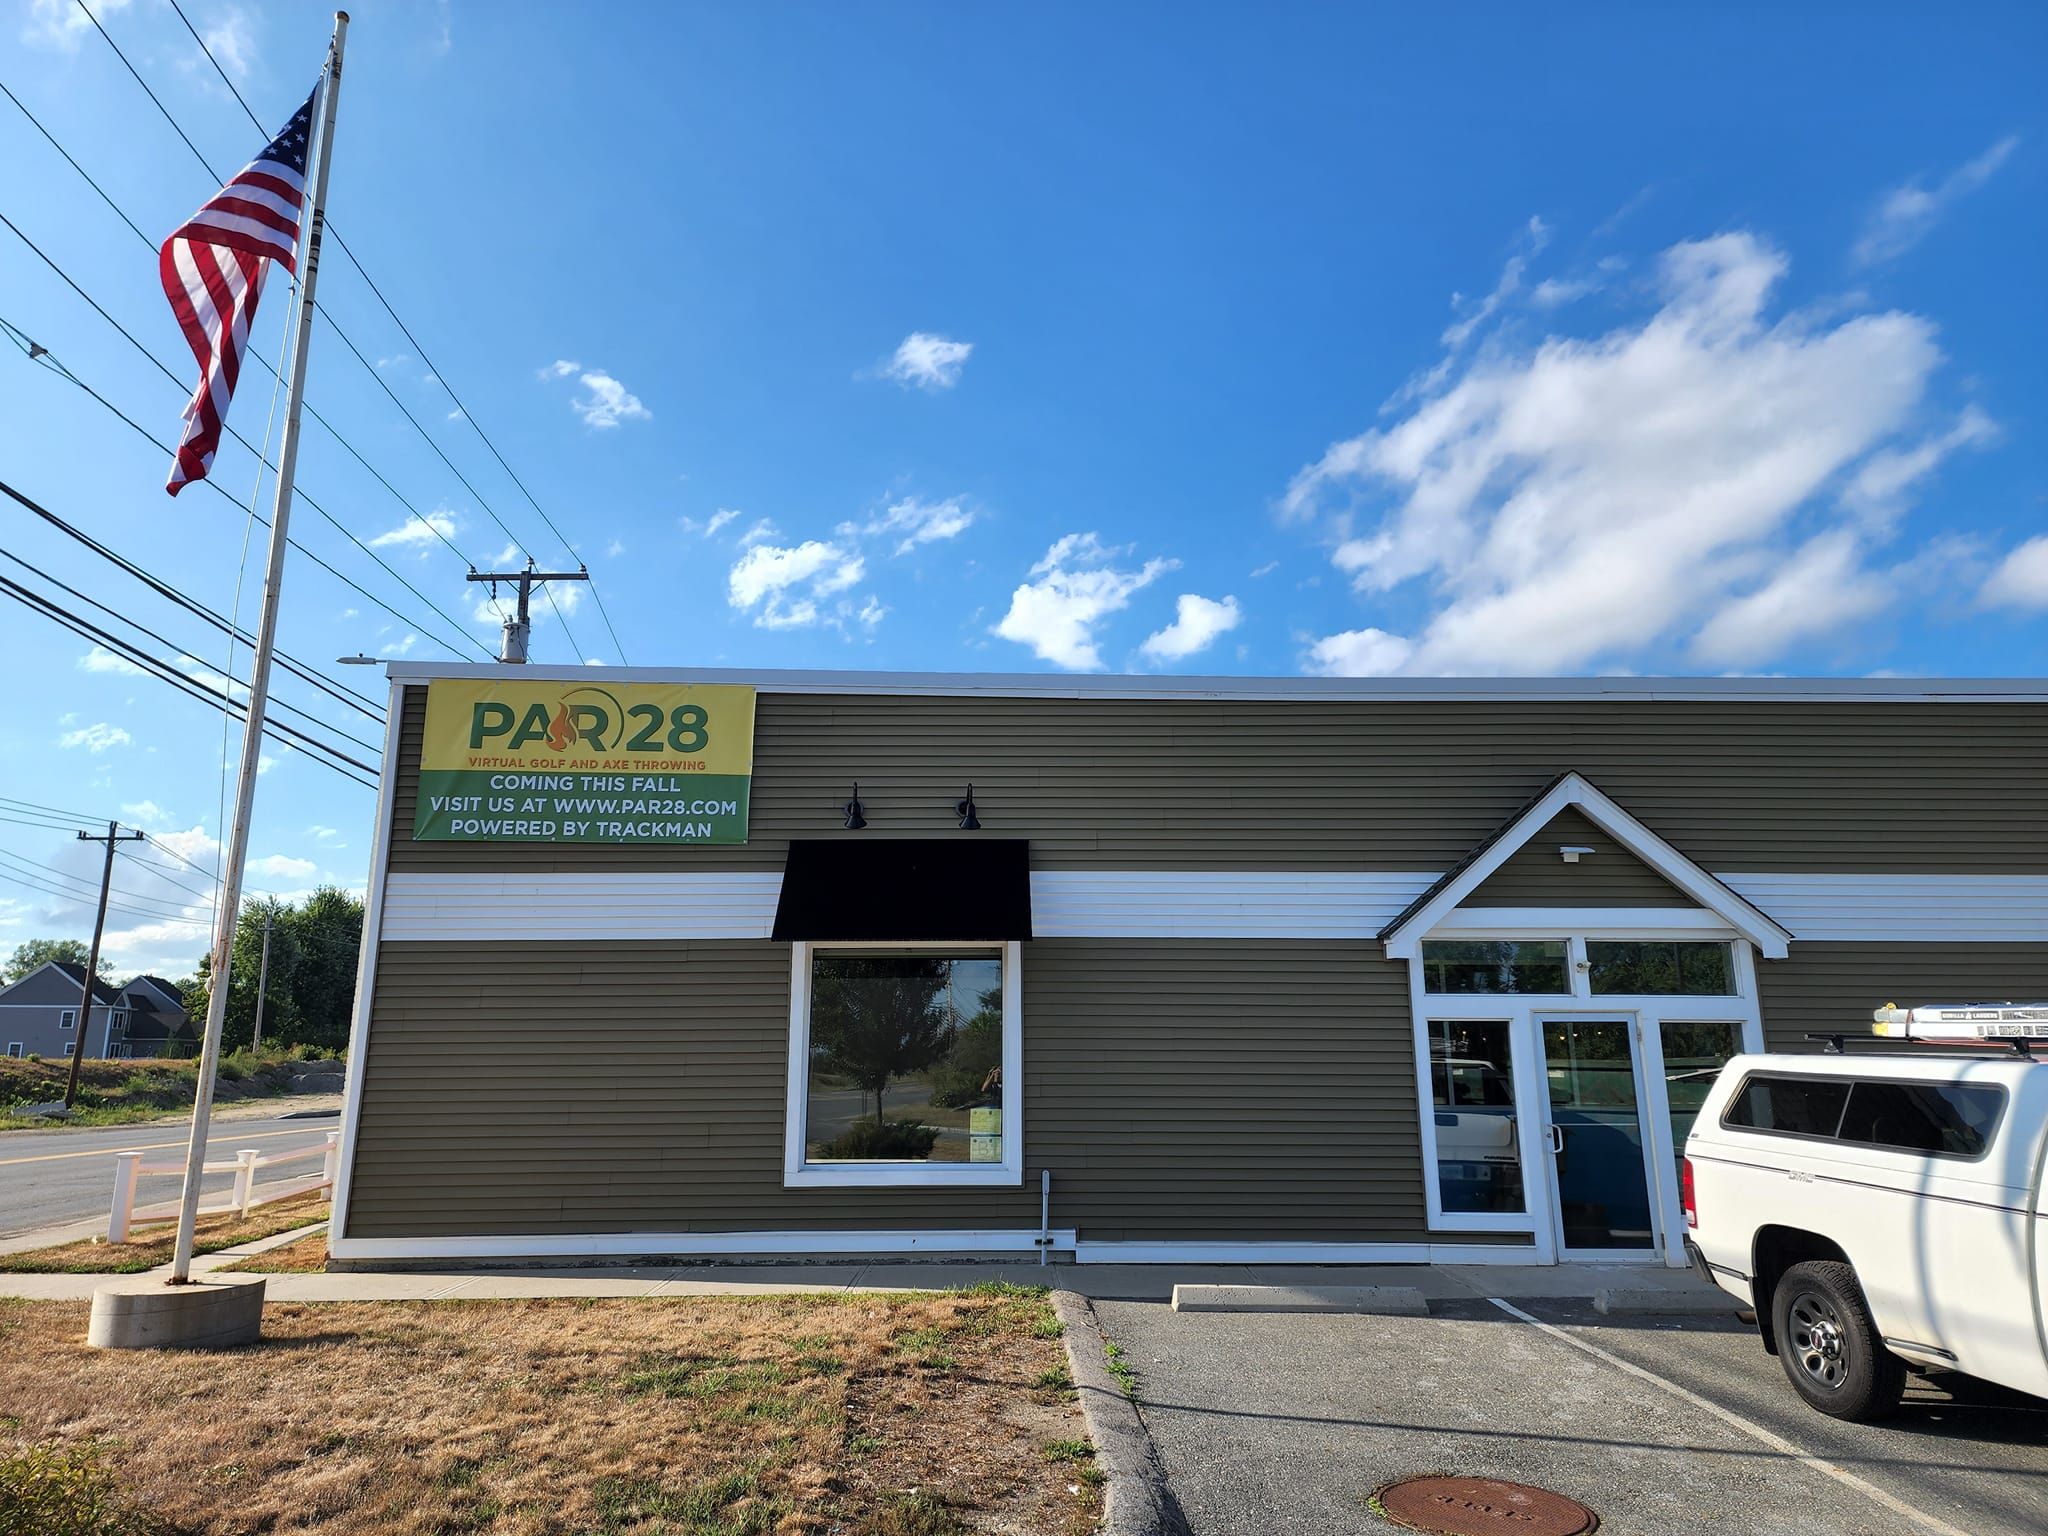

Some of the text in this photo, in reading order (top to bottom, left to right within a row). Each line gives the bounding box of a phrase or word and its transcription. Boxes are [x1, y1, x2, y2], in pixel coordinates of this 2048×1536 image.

[468, 702, 709, 753] PAR 28
[469, 757, 706, 771] VIRTUAL GOLF AND AXE THROWING
[490, 775, 681, 792] COMING THIS FALL
[430, 796, 737, 815] VISIT US AT WWW.PAR28.COM
[451, 819, 711, 837] POWERED BY TRACKMAN
